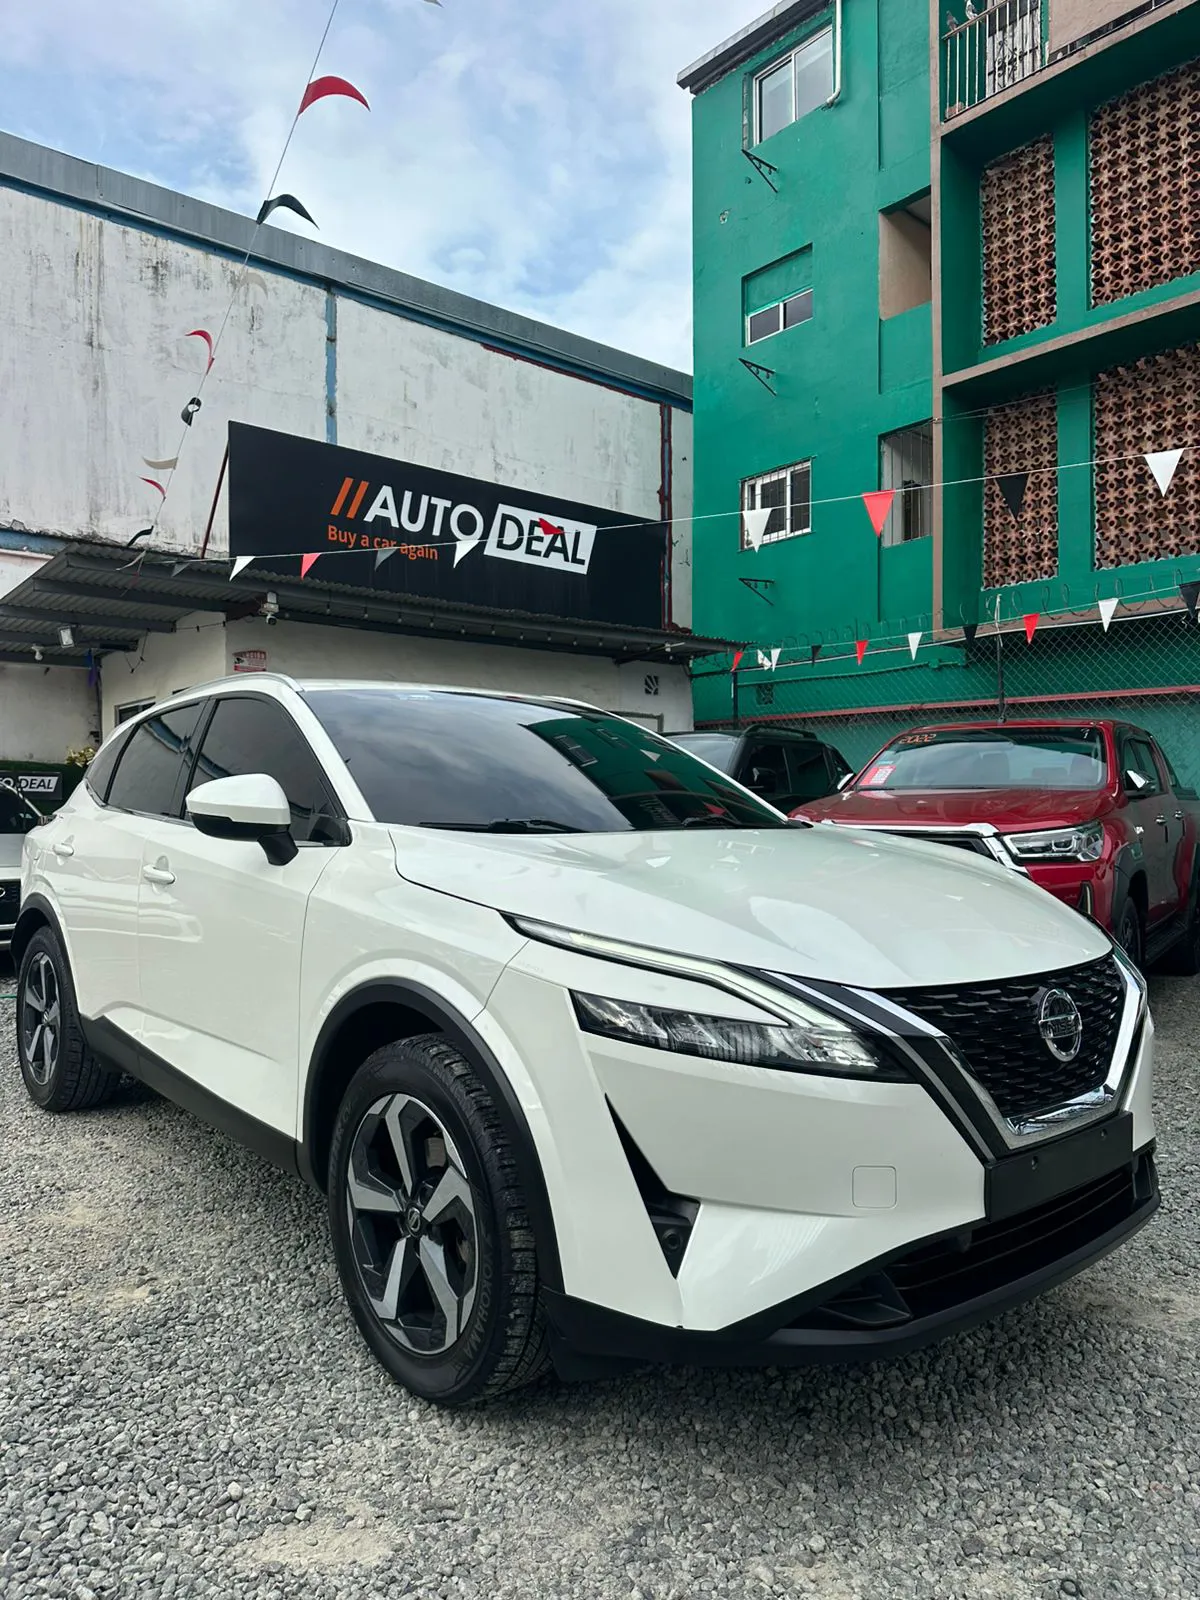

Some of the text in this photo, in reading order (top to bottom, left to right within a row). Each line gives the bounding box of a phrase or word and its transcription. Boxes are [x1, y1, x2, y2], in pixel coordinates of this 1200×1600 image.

[328, 525, 438, 561] Buy a car again
[363, 485, 586, 566] AUTO DEAL
[19, 777, 53, 790] DEAL
[1046, 1017, 1079, 1036] NISS
[463, 1250, 494, 1360] YOKOHAMA
